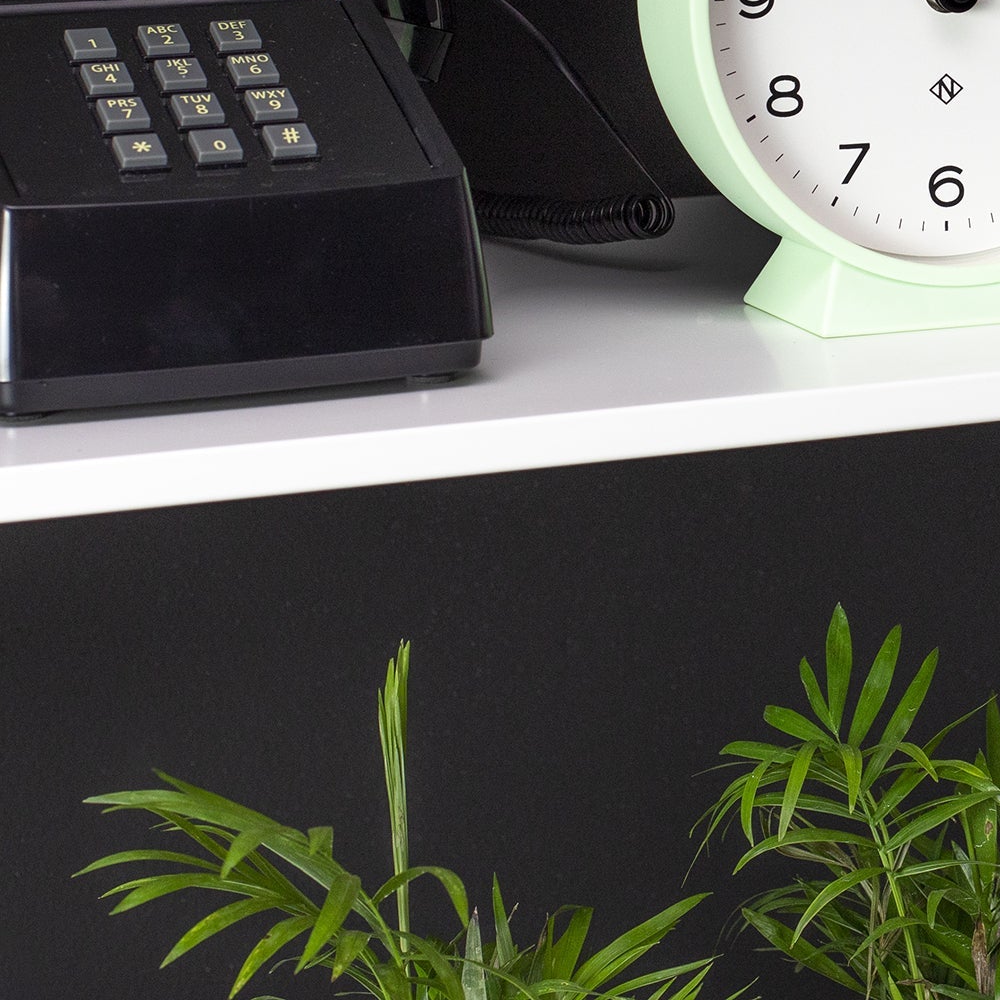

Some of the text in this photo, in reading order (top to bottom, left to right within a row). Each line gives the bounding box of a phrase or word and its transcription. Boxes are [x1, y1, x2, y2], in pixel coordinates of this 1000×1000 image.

[146, 25, 178, 34] ABC
[217, 21, 247, 30] DEF
[161, 34, 174, 44] 2
[233, 30, 244, 40] 3
[88, 39, 97, 48] 1
[166, 58, 192, 68] JKL
[231, 54, 268, 64] MNO
[91, 63, 120, 73] GHI
[177, 66, 188, 75] 5
[249, 64, 262, 74] 6
[105, 73, 117, 83] 4
[180, 94, 211, 104] TUV
[251, 89, 286, 99] WXY
[766, 74, 804, 118] 8
[107, 98, 137, 108] PRS
[269, 99, 281, 110] 9
[121, 108, 133, 119] 7
[195, 104, 209, 115] 8
[838, 142, 871, 185] 7
[928, 165, 965, 208] 6
